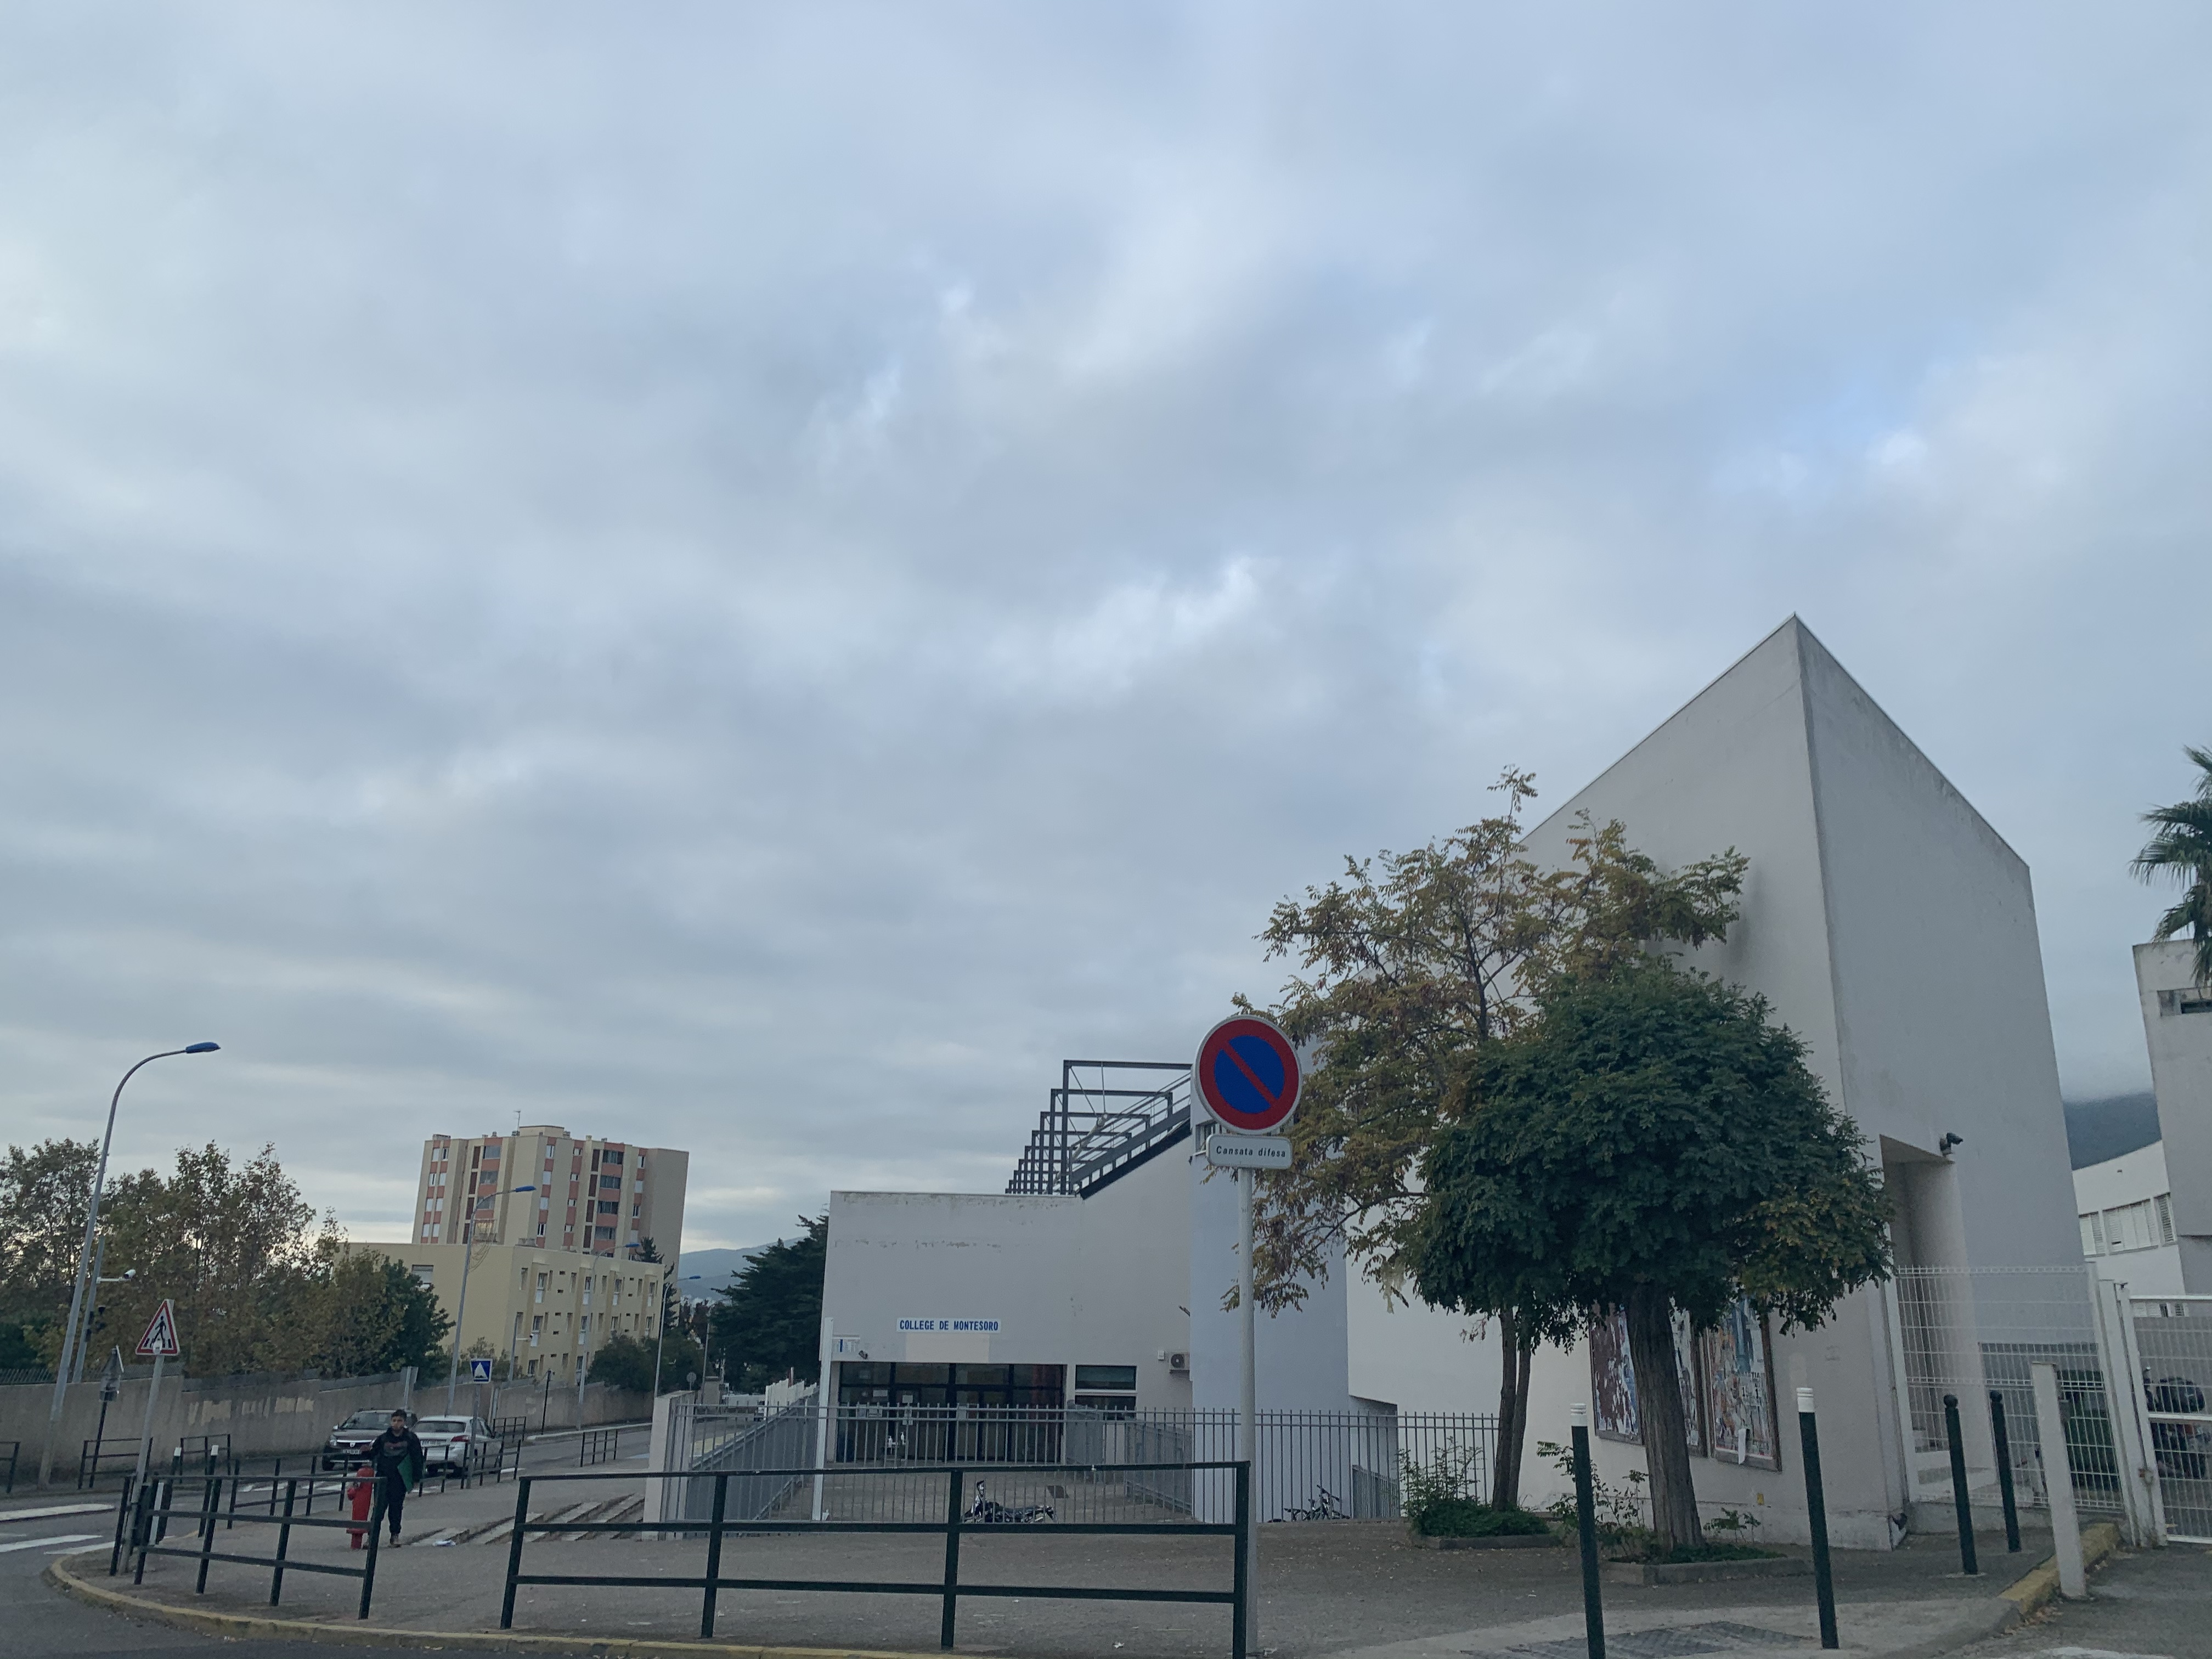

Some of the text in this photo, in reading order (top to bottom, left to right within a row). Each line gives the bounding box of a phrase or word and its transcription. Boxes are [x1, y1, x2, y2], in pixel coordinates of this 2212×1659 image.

[1216, 1145, 1285, 1157] Cansata difesa
[900, 1319, 999, 1331] COLLEGE DE MONTESORO
